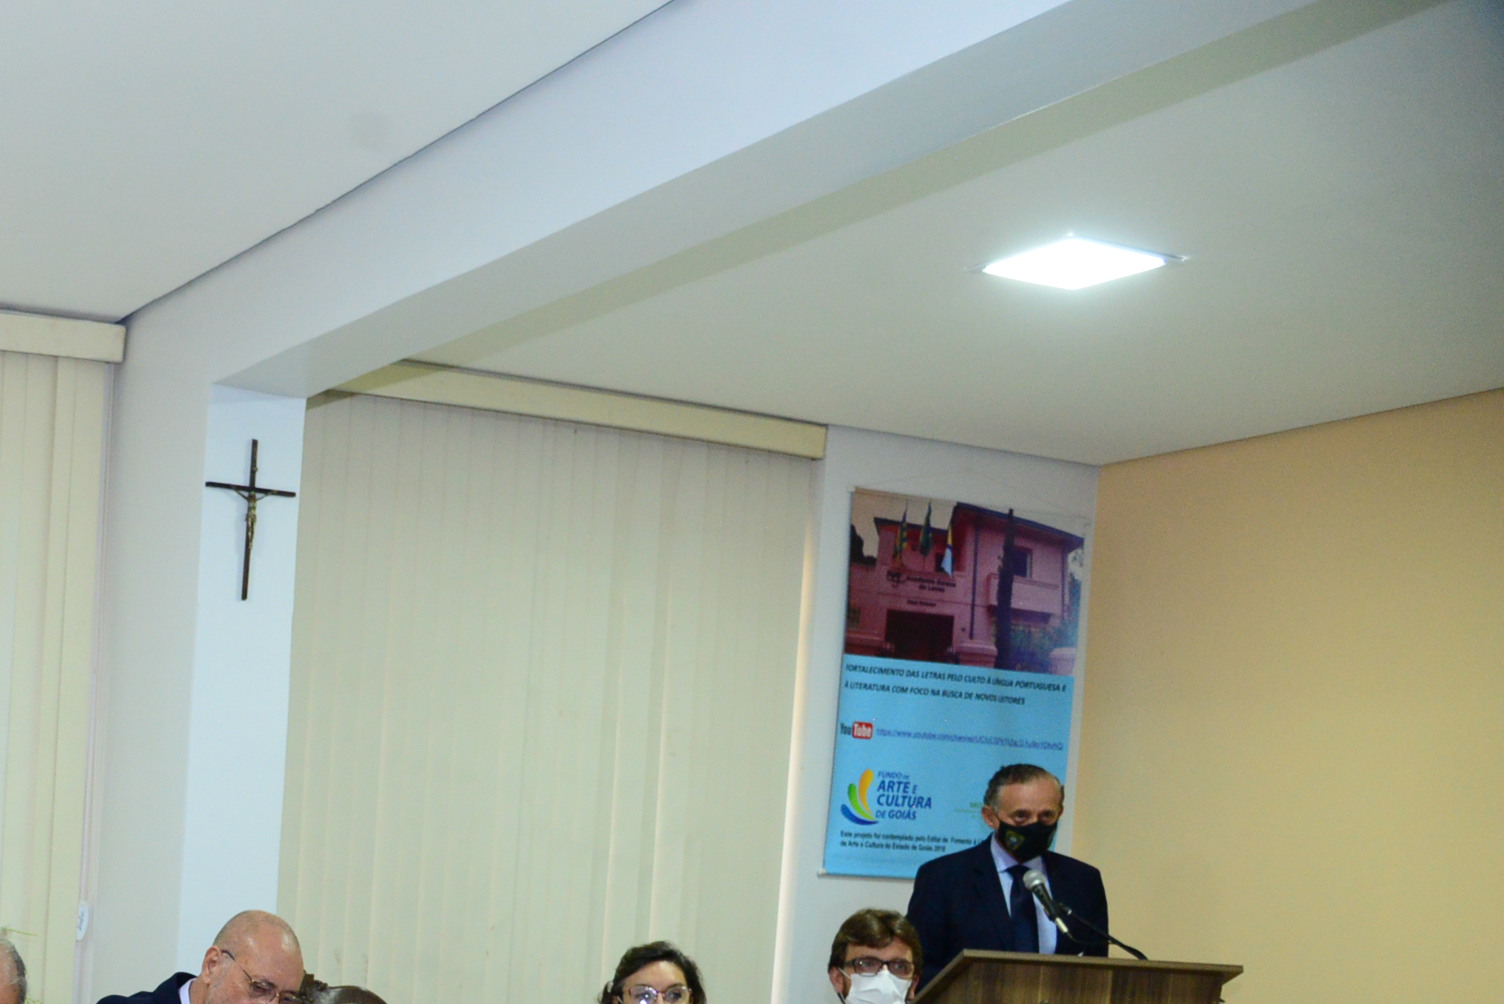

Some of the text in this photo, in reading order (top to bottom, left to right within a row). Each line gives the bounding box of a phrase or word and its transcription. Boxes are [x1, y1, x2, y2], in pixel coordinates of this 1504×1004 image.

[846, 664, 905, 677] FORTALECIMENTO
[906, 670, 920, 678] DAS
[921, 671, 946, 681] LETRAS
[947, 673, 963, 682] PELO
[964, 675, 986, 684] CULTO
[1015, 680, 1060, 692] PORTUGUESA
[850, 681, 890, 692] LITERATURA
[892, 685, 908, 694] COM
[910, 686, 929, 696] FOCO
[931, 688, 940, 697] NA
[942, 689, 962, 699] BUSCA
[964, 691, 974, 700] DE
[976, 692, 996, 702] NOVOS
[877, 771, 902, 780] FUNDO
[877, 780, 918, 795] ARTE E
[877, 793, 932, 809] CULTURA
[876, 809, 917, 820] DE GOIÁS
